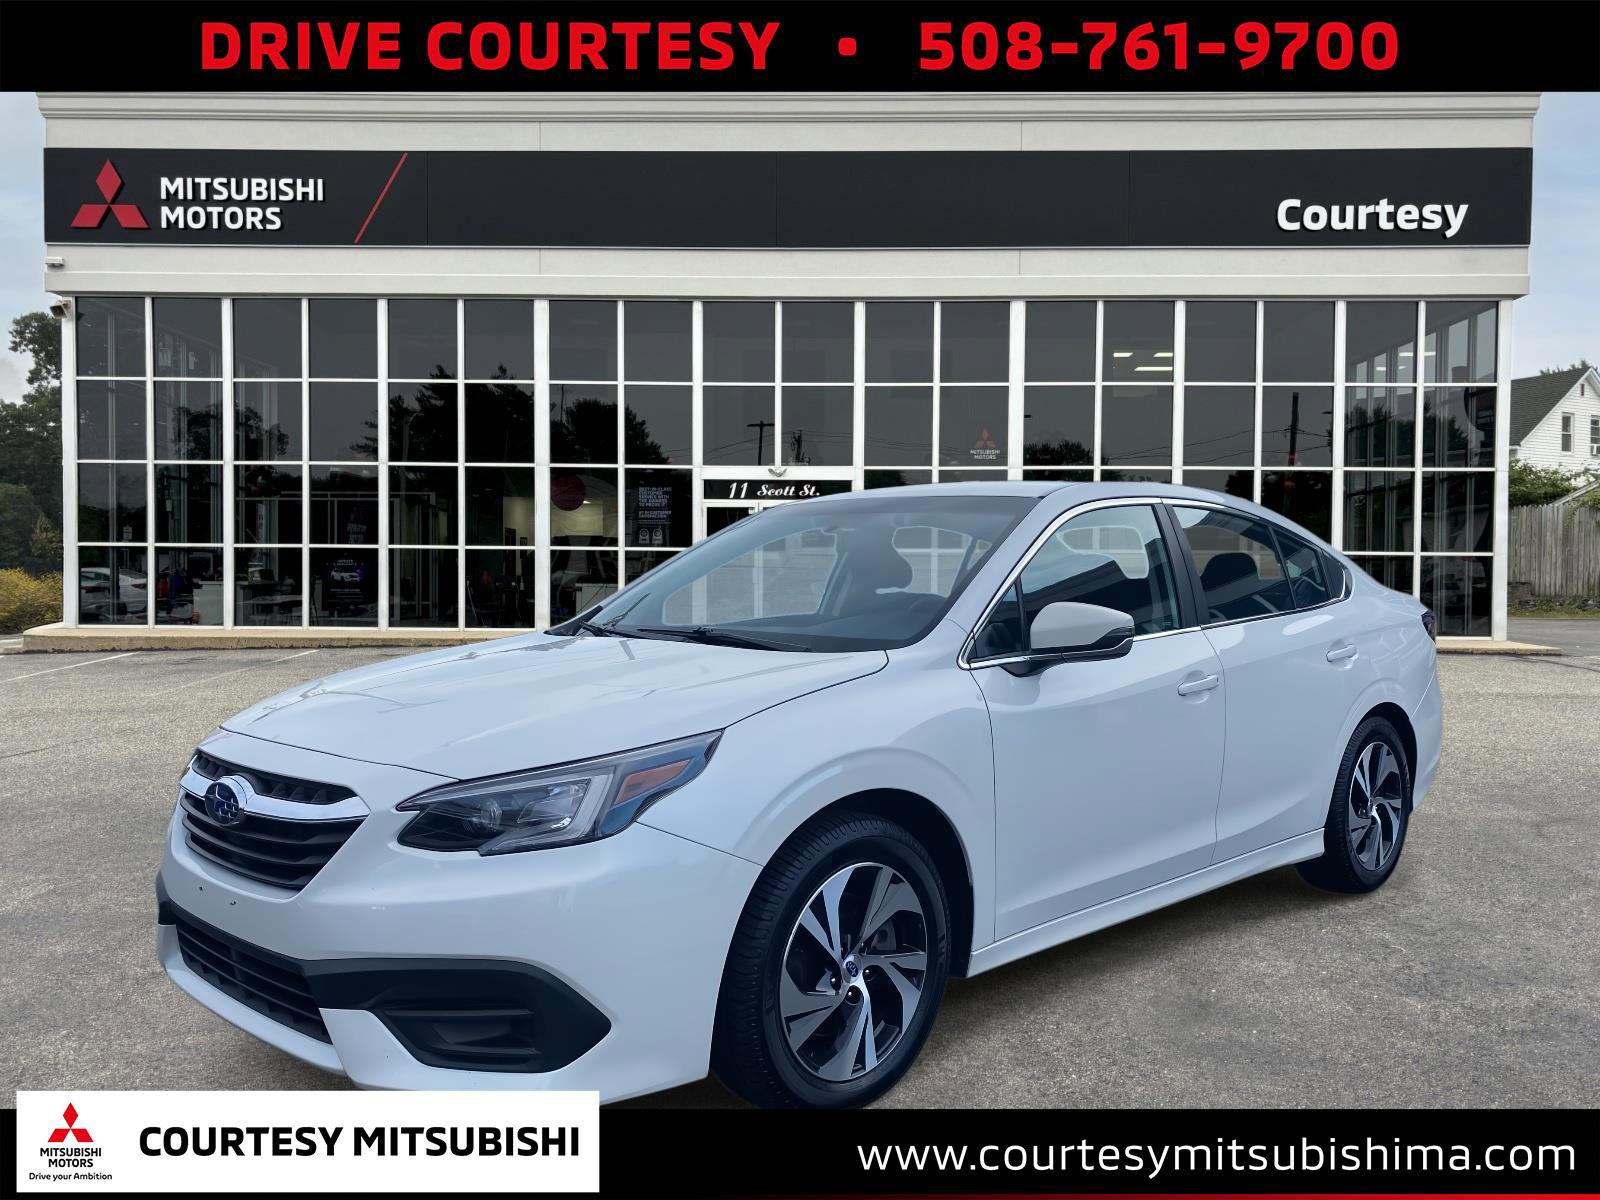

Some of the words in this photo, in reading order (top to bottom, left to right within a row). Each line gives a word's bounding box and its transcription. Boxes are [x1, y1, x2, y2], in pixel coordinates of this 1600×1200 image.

[160, 176, 324, 202] MITSUBISHI
[160, 205, 282, 230] MOTORS
[1277, 198, 1469, 238] Courtesy
[729, 482, 748, 499] 11
[756, 484, 796, 497] Scott
[799, 484, 821, 497] St.
